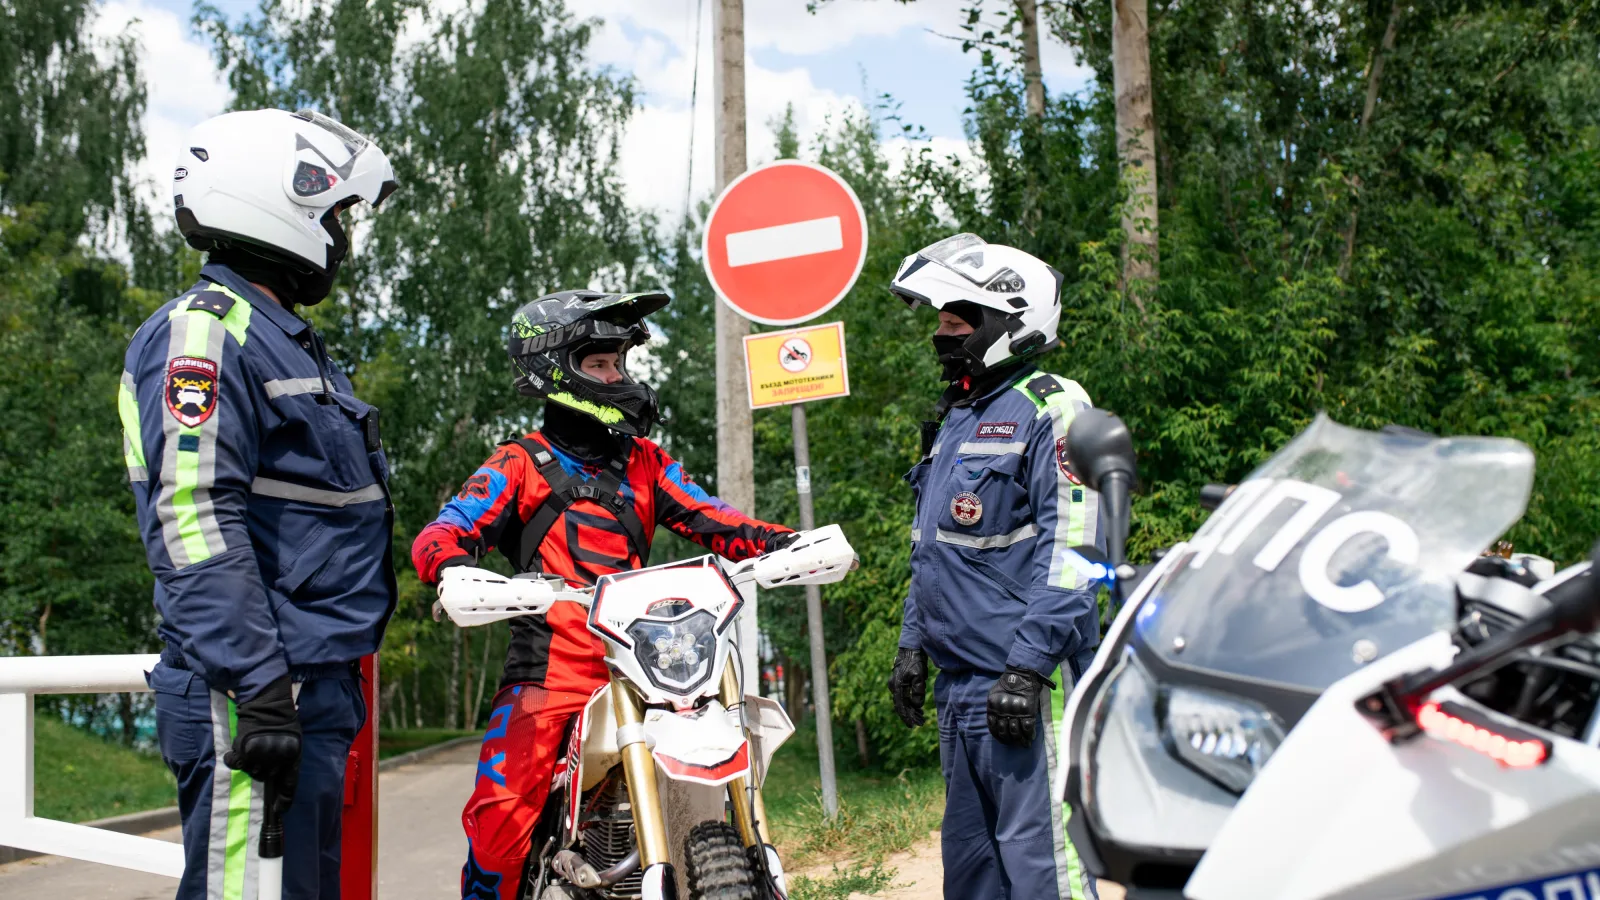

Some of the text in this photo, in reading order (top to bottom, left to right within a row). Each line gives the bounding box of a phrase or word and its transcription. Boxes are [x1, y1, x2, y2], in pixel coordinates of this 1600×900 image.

[522, 320, 586, 355] 100%
[172, 359, 215, 373] ПОЛИЦИЯ
[784, 374, 834, 385] МОТОТЕХНИКИ
[980, 425, 1014, 434] ДПС ГИБДД
[1185, 477, 1420, 613] ДПС
